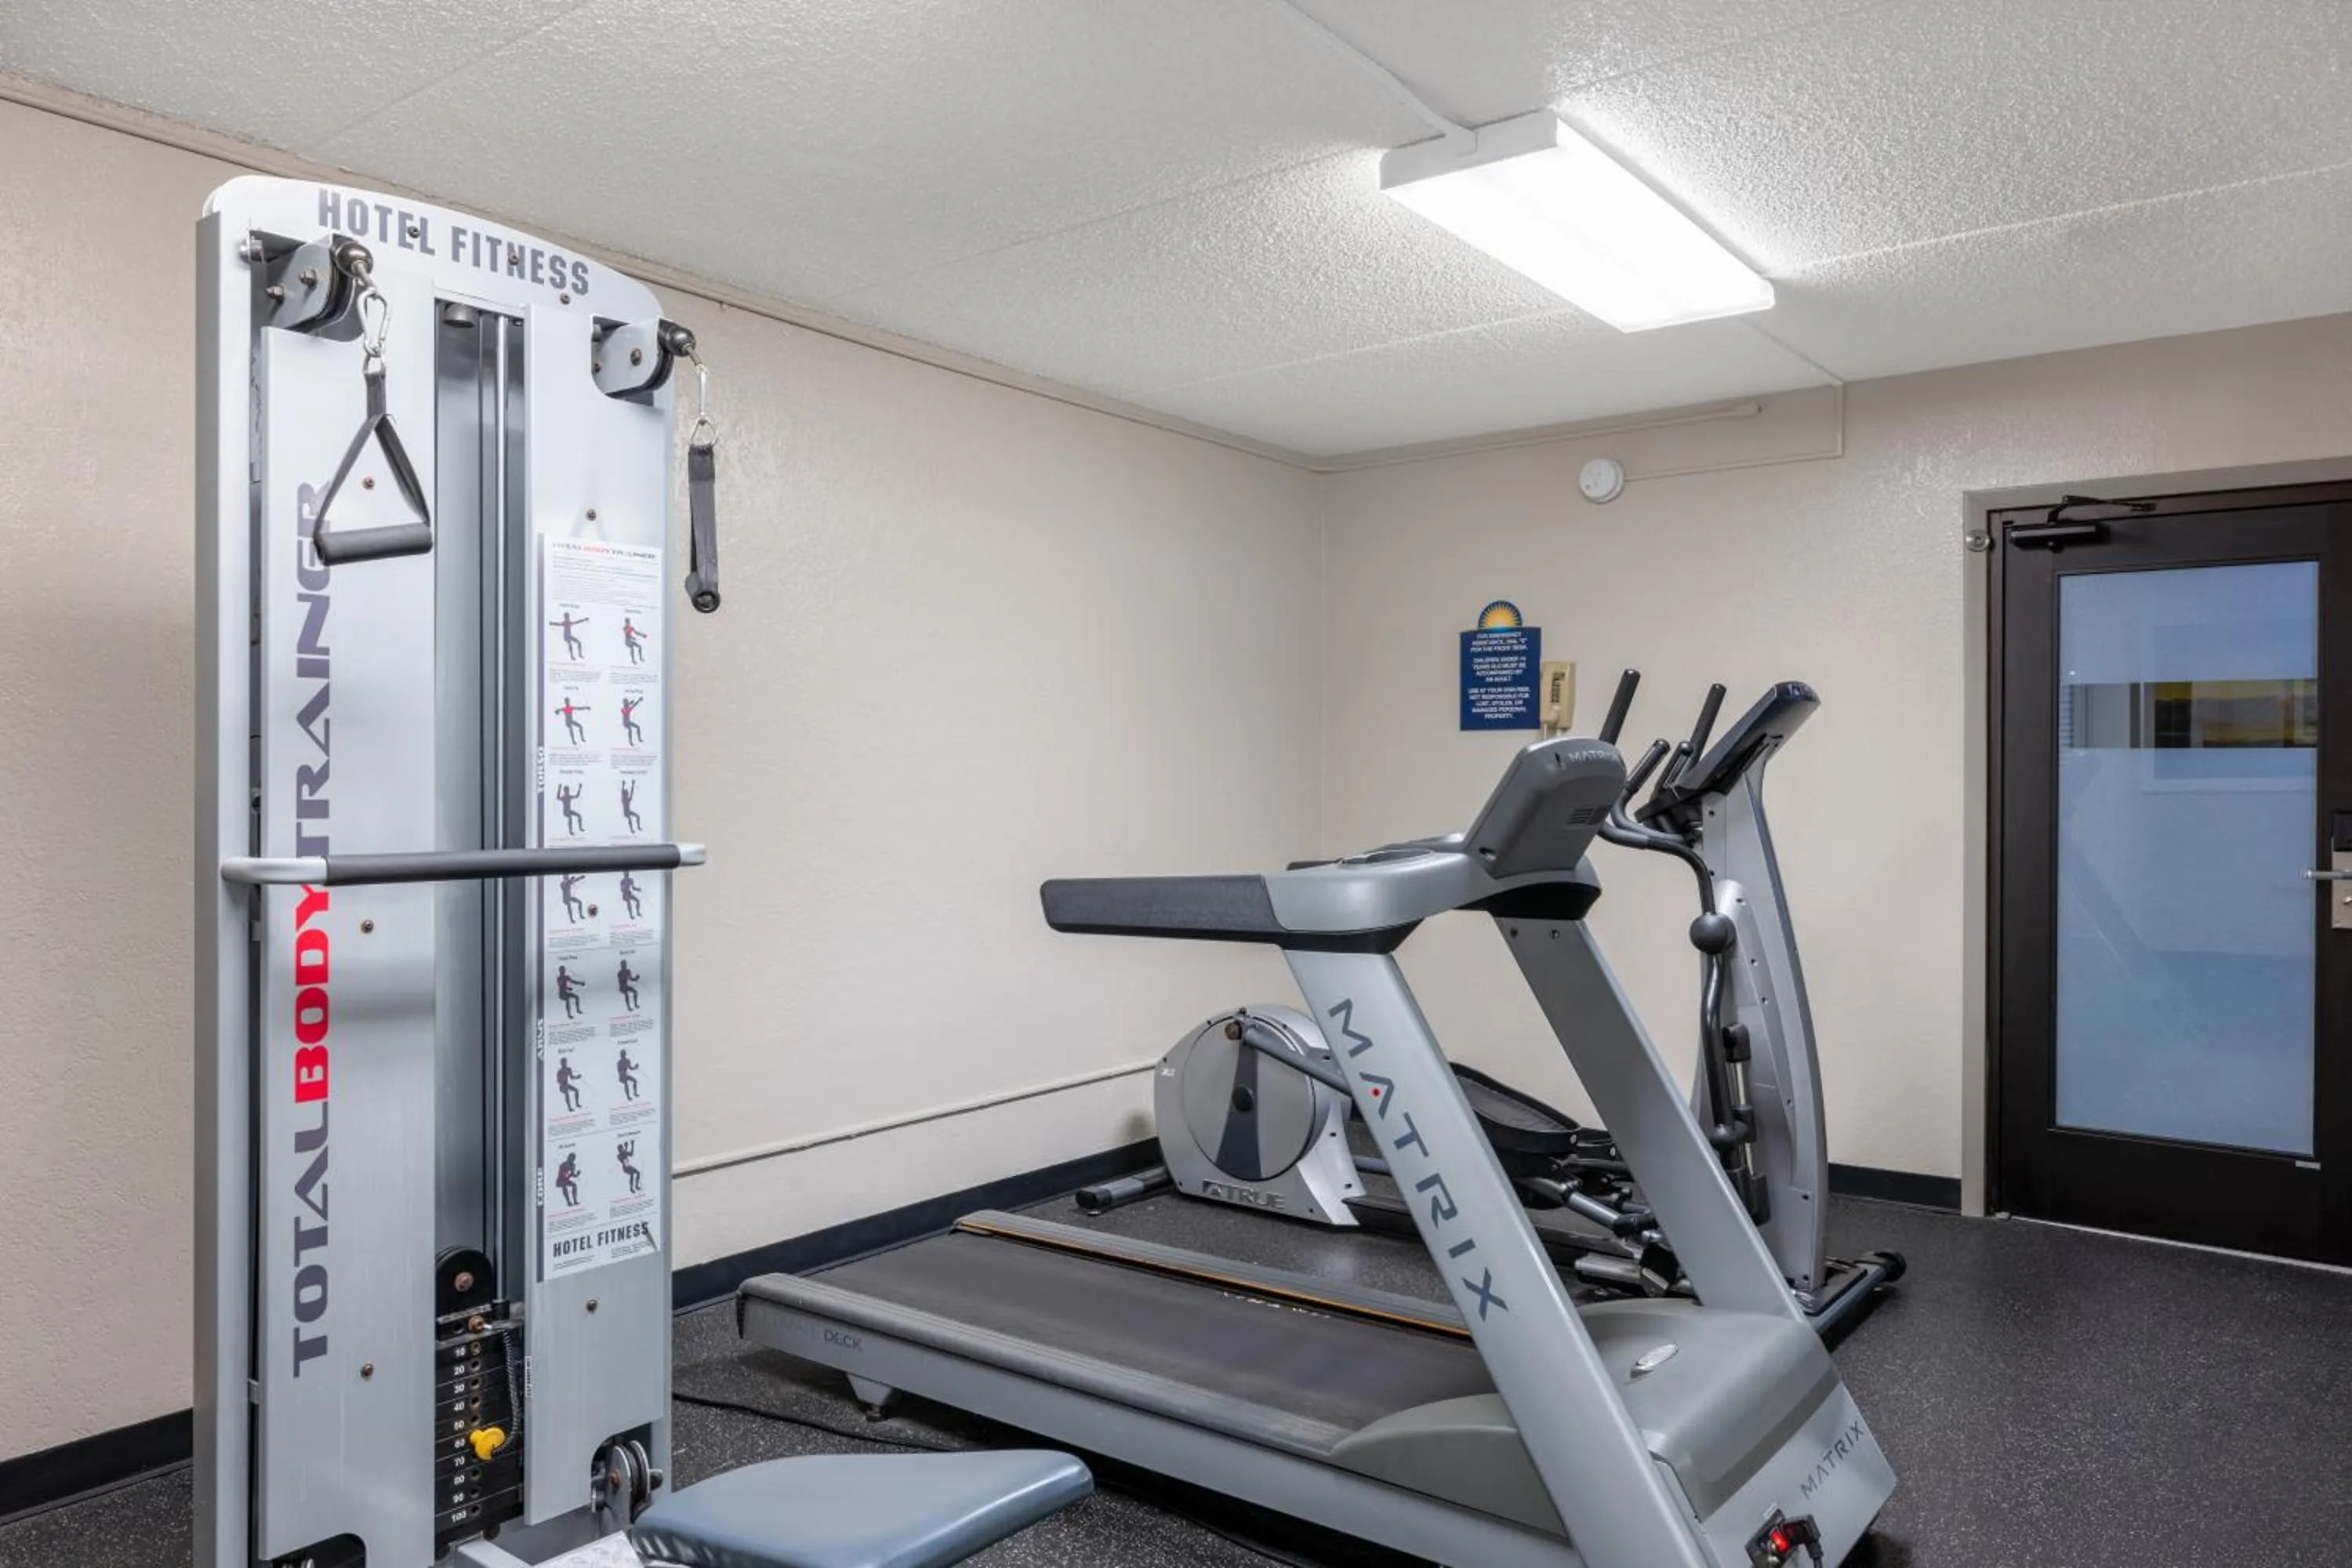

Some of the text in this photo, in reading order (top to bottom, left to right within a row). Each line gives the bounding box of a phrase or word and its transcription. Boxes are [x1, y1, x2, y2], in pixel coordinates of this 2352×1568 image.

[318, 188, 590, 296] HOTEL FITNESS
[294, 884, 329, 1103] BODY
[1328, 997, 1509, 1322] MATRIX
[293, 1102, 328, 1378] TOTAL
[553, 1235, 593, 1258] HOTEL
[597, 1222, 649, 1247] FITNESS
[824, 1330, 862, 1352] DECK
[1800, 1421, 1864, 1500] MATRIX
